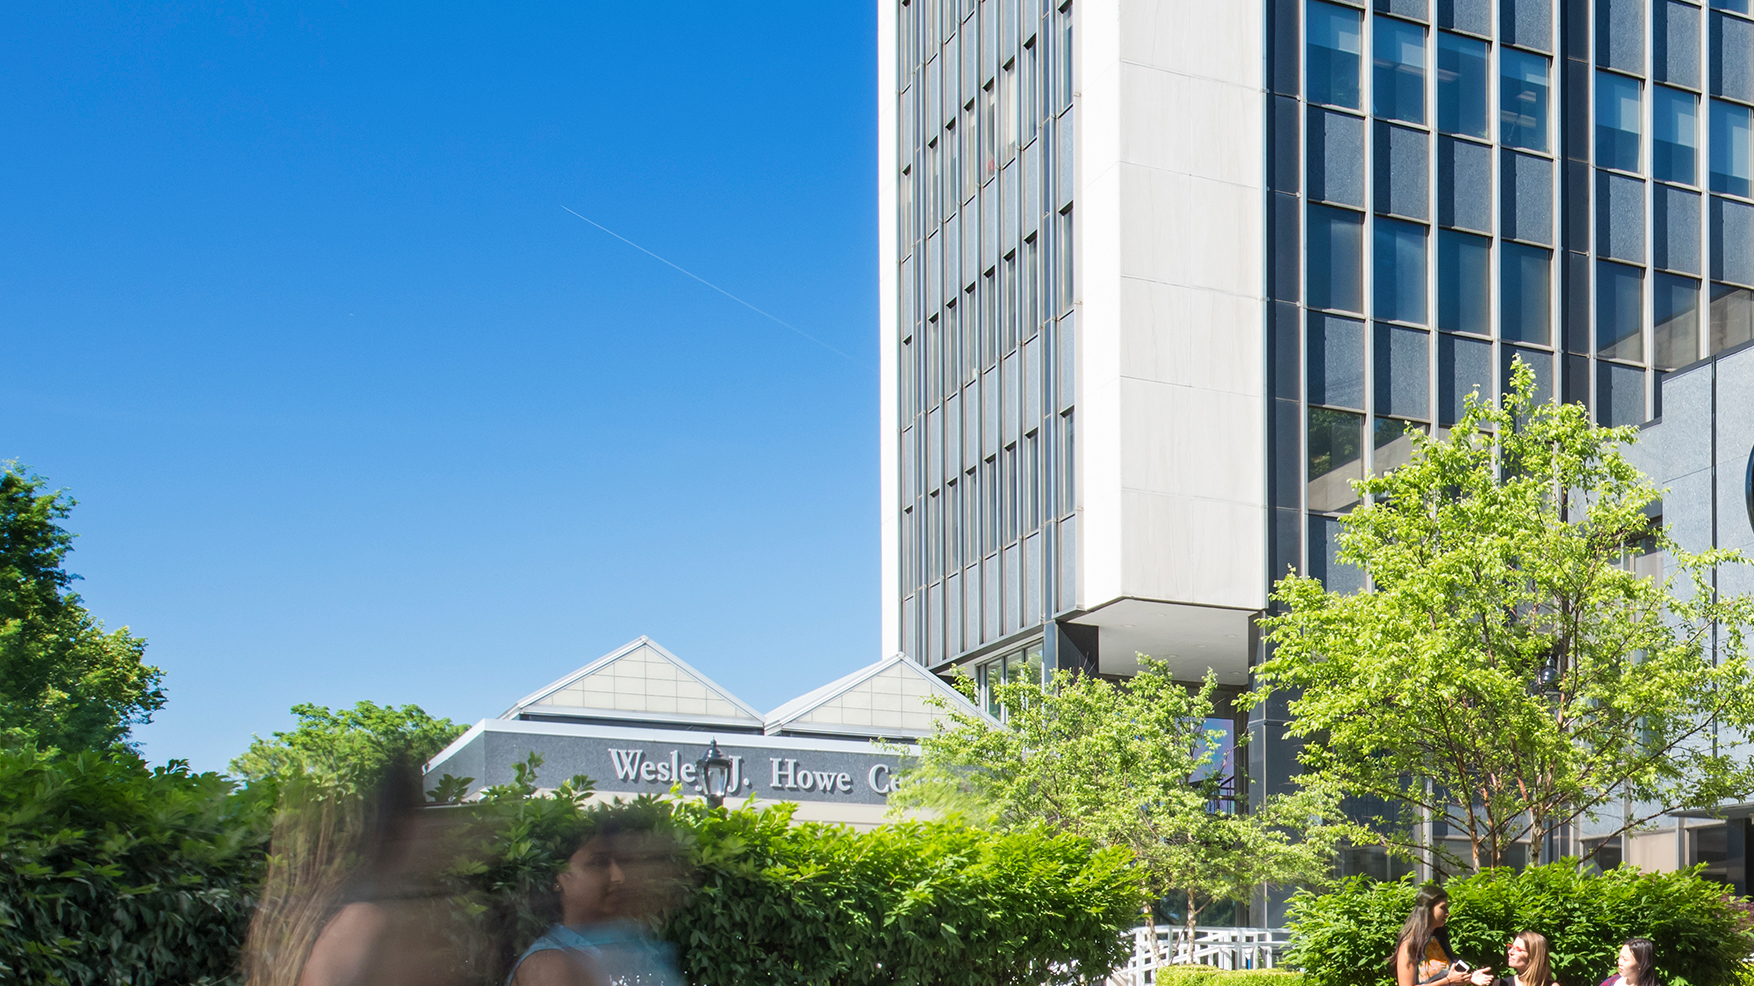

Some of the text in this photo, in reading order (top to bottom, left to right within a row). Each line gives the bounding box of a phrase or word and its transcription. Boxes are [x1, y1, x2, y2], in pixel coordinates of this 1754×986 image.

[608, 748, 704, 792] Wesle
[726, 755, 750, 793] J.
[769, 757, 852, 792] Howe
